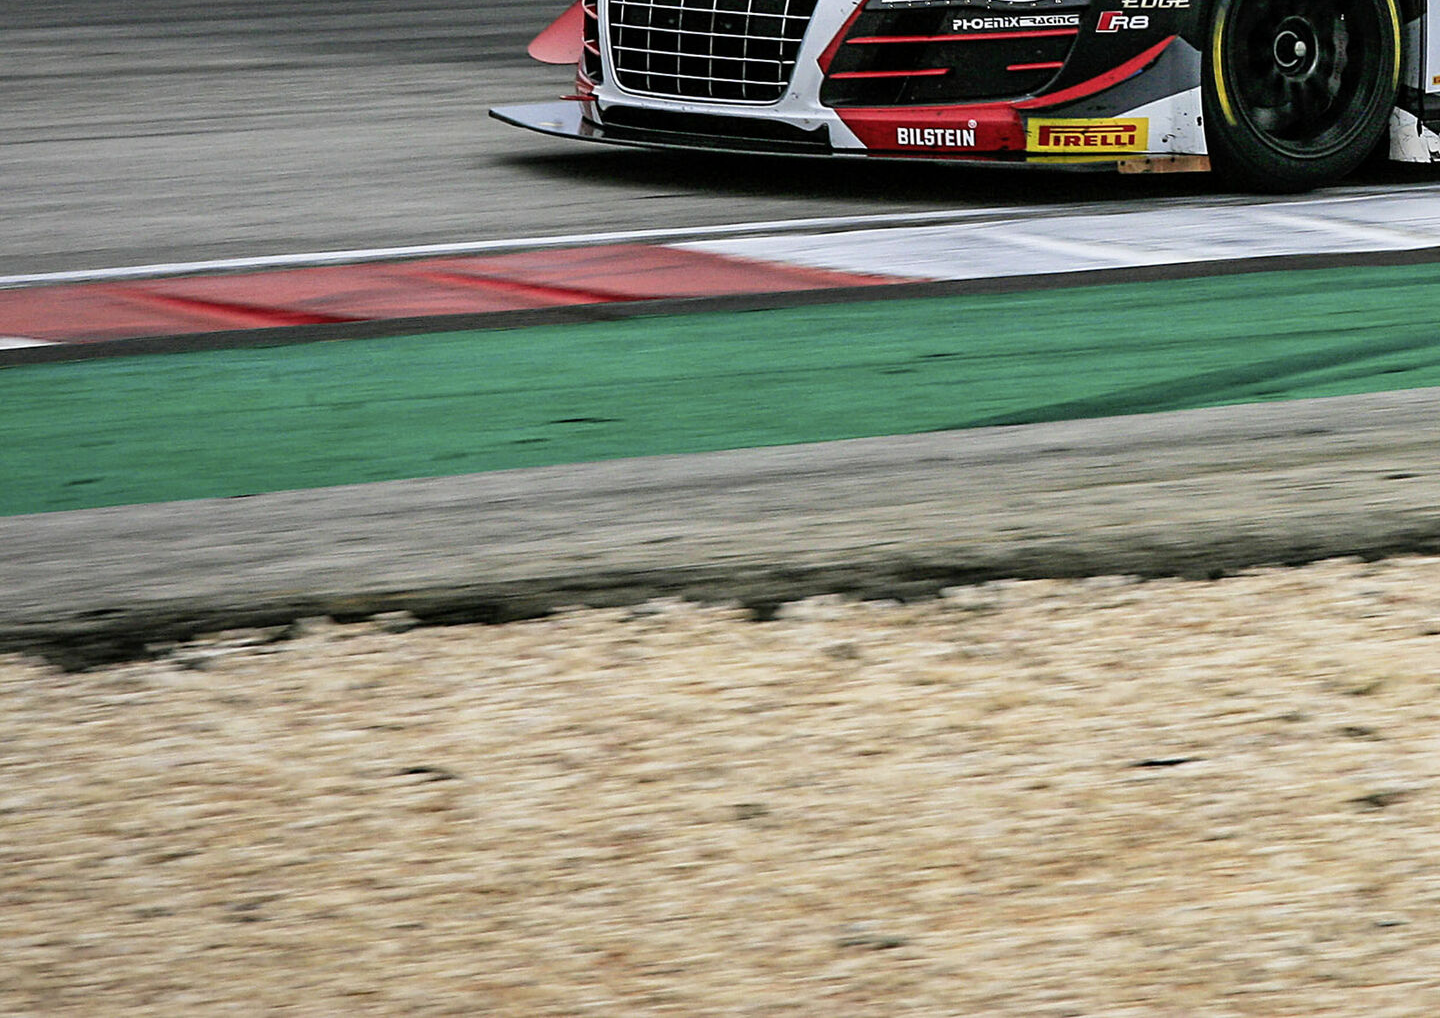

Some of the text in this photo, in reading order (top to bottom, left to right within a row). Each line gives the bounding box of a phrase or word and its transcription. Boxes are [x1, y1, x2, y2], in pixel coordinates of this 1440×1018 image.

[1109, 15, 1149, 30] R8
[897, 127, 976, 146] BILSTEIN
[1038, 124, 1137, 146] PIRELLI
